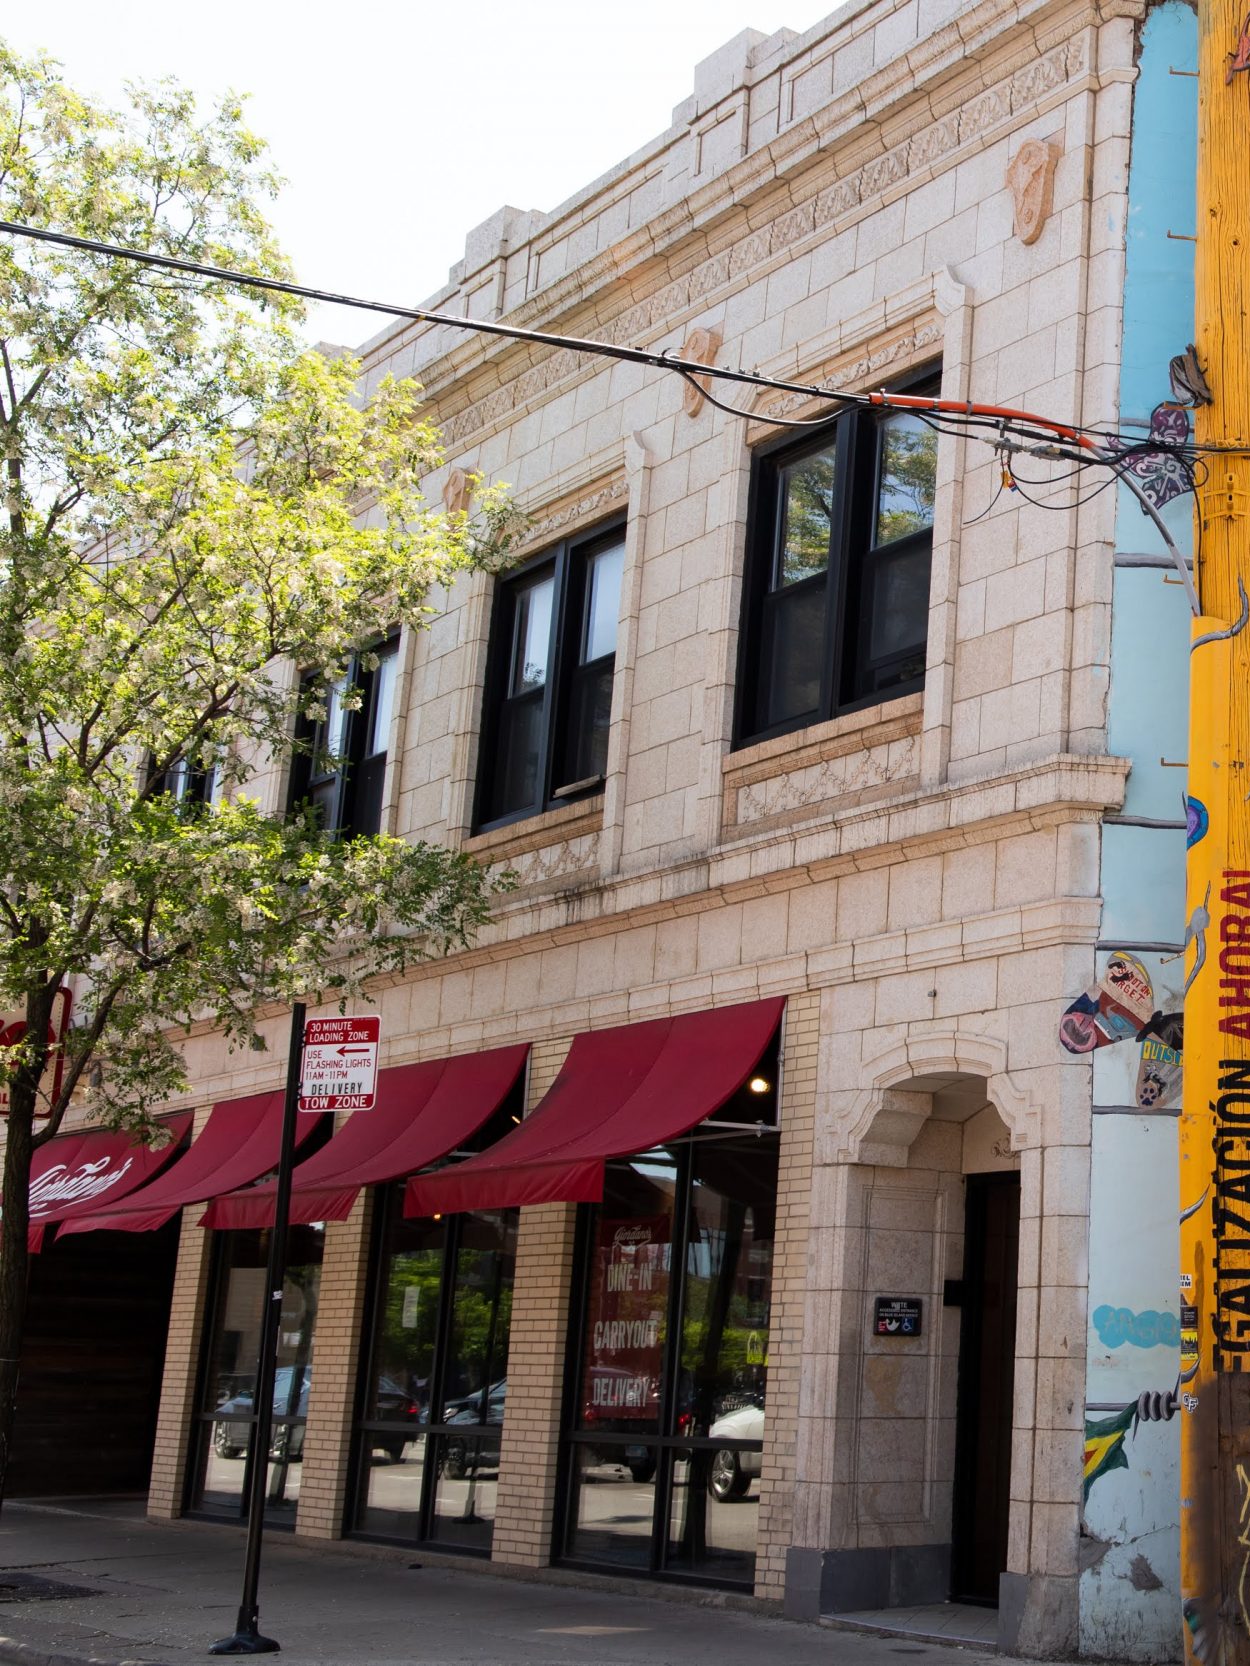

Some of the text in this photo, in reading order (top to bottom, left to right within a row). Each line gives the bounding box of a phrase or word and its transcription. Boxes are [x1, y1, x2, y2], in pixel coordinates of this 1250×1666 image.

[311, 1021, 353, 1032] 30 MINUTE
[309, 1031, 369, 1043] LOADING ZONE
[307, 1050, 322, 1059] USE
[1144, 1040, 1183, 1066] OUTSI
[306, 1059, 372, 1069] FLASHING LIGHTS
[311, 1082, 362, 1096] DELIVERY
[304, 1095, 367, 1109] TOW ZONE
[607, 1263, 652, 1292] DINE-IN
[594, 1320, 658, 1349] CARRYOUT
[592, 1378, 650, 1408] DELIVERY
